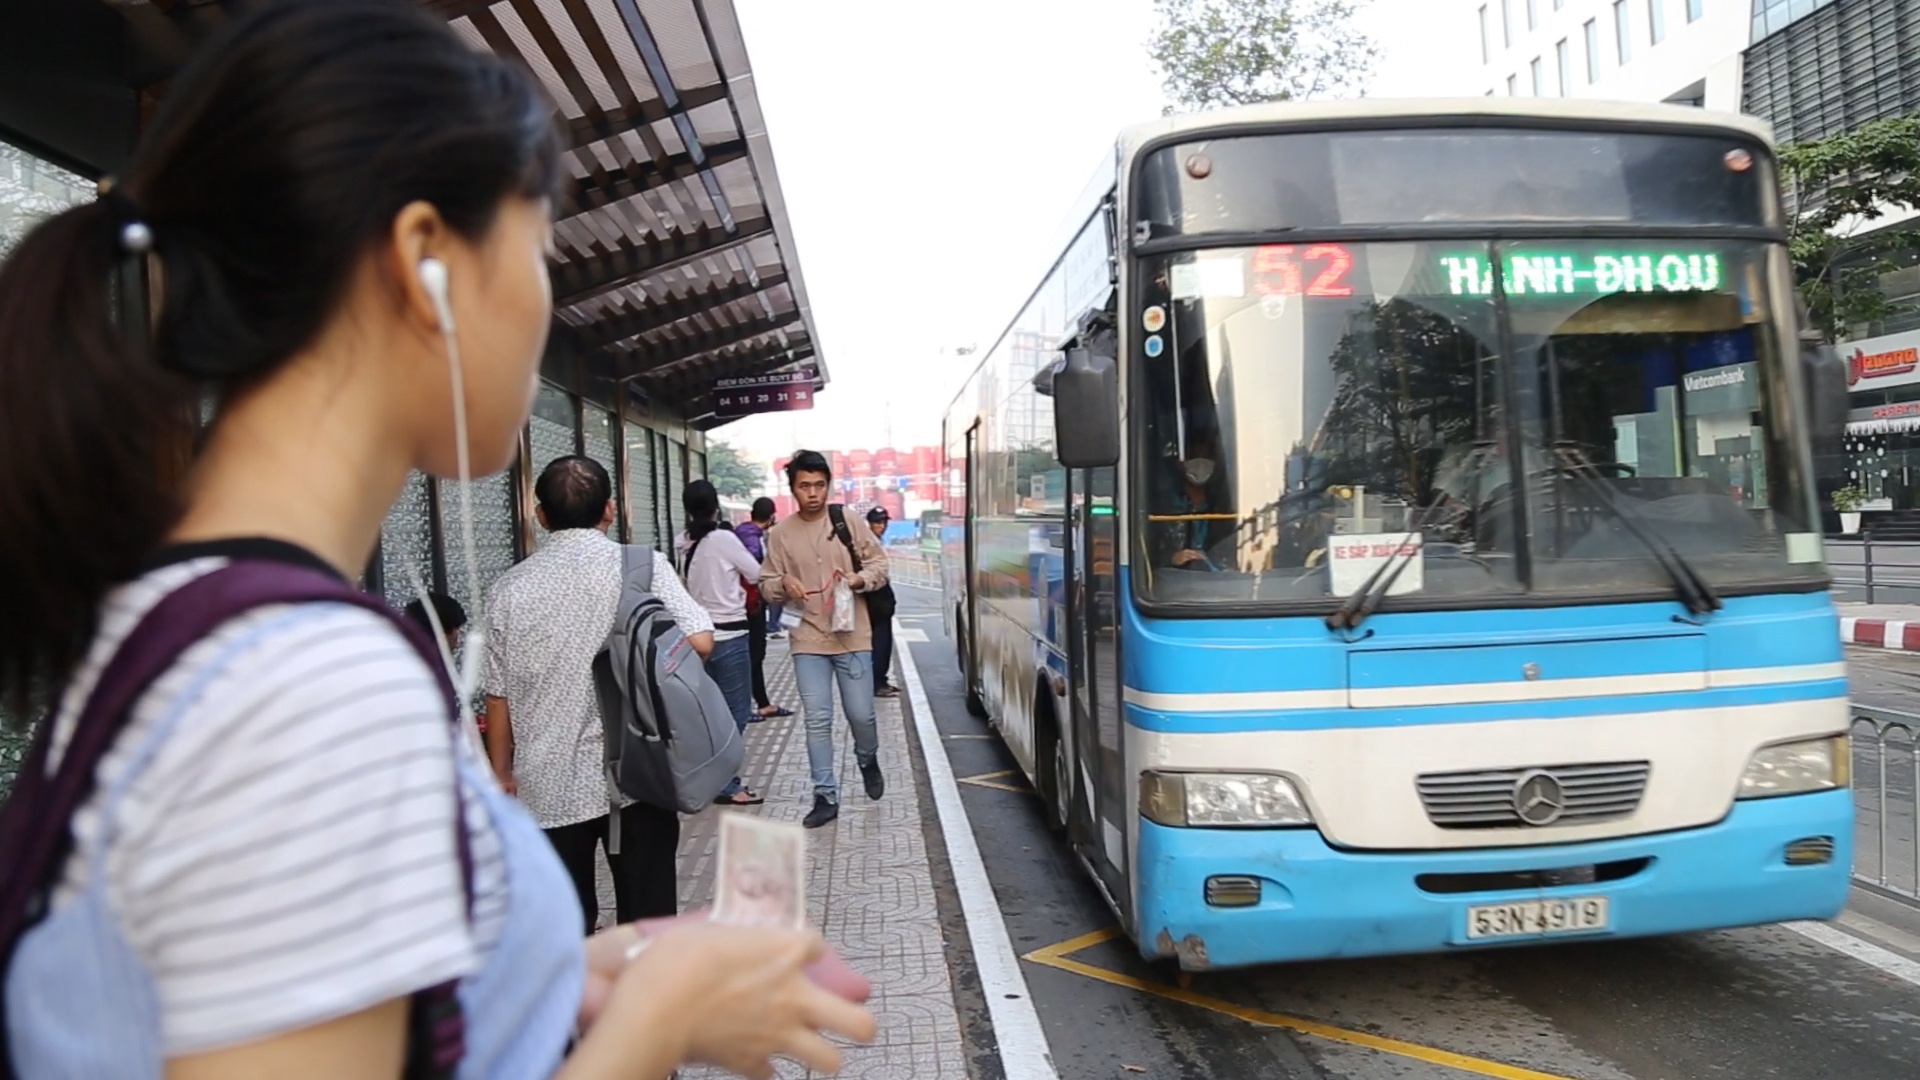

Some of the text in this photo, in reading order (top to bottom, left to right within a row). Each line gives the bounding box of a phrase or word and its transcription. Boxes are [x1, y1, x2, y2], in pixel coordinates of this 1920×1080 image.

[1254, 243, 1355, 296] 52
[1684, 367, 1745, 391] Vietcombank
[719, 397, 731, 406] 04
[777, 392, 788, 401] 31
